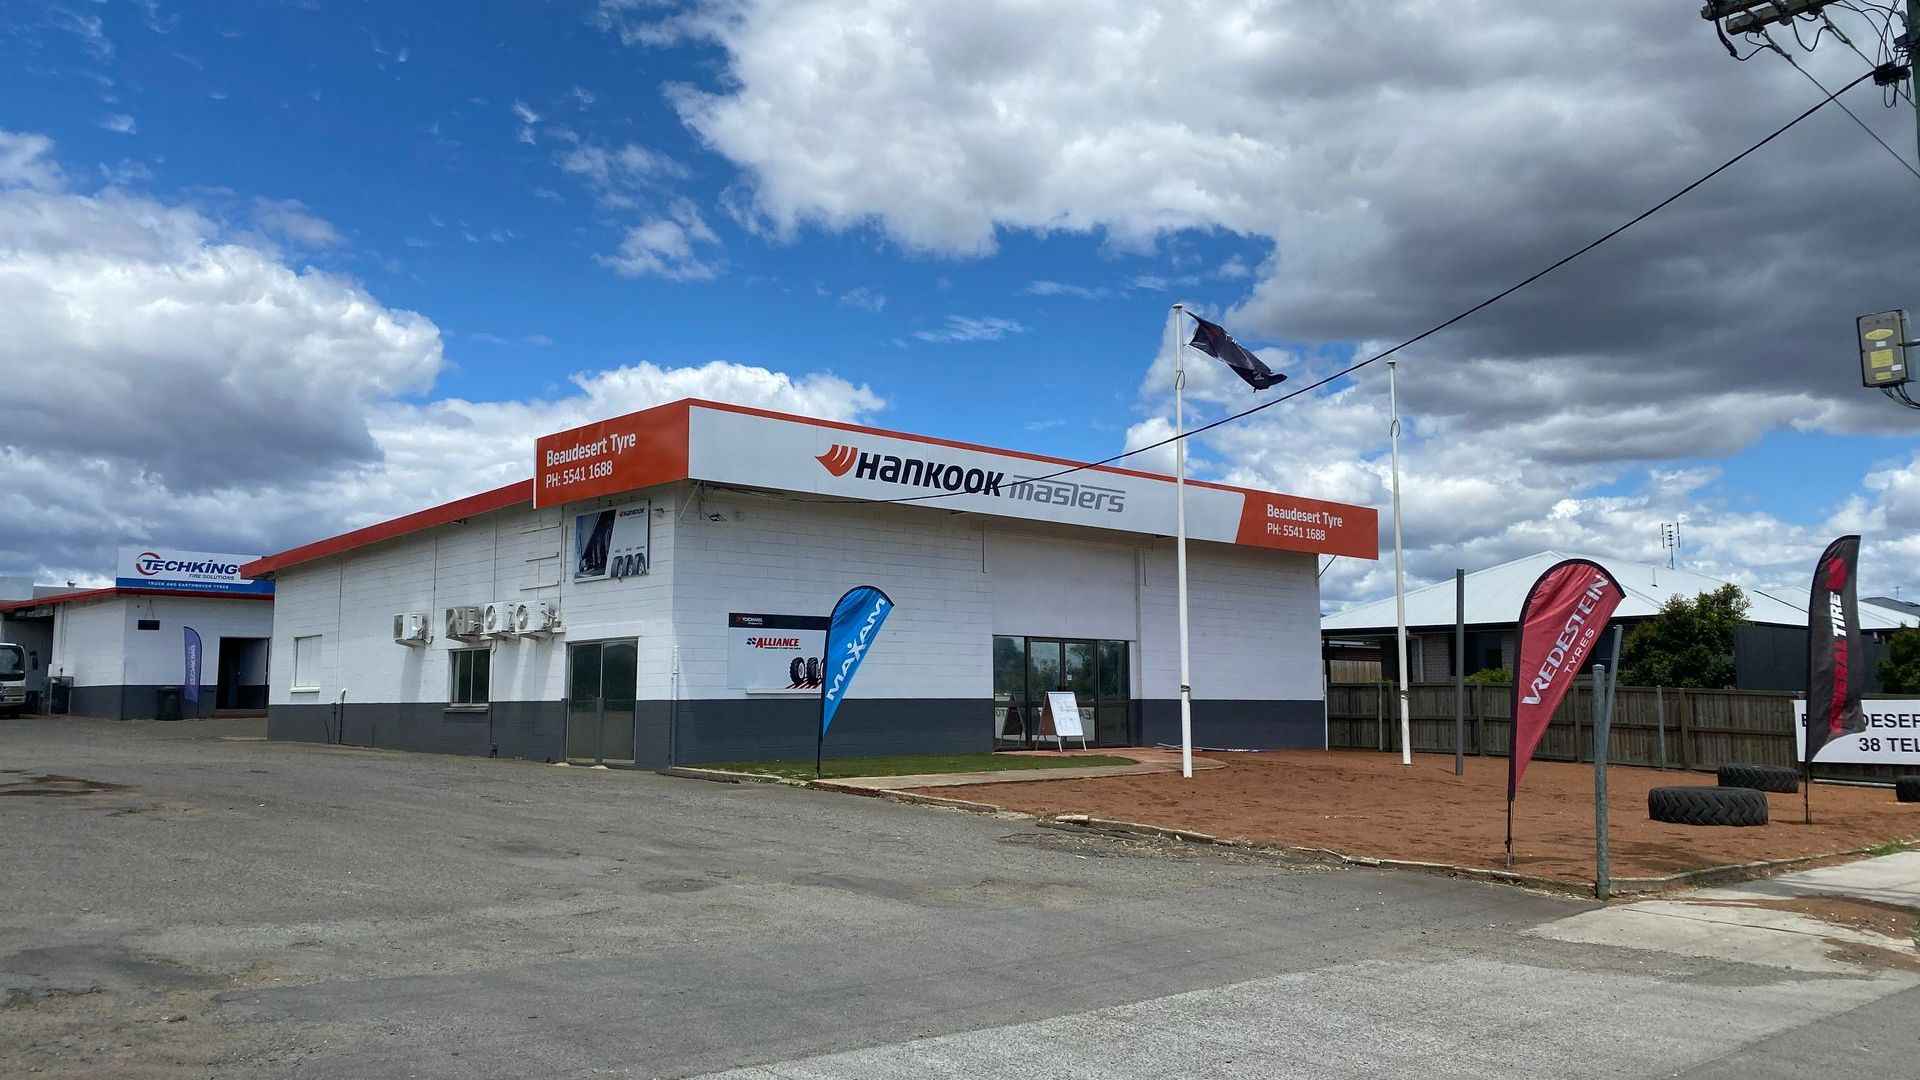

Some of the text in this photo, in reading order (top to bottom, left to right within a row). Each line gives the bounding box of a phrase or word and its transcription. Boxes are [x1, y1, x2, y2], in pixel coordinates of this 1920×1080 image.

[546, 433, 636, 467] Beaudesert Tyre
[545, 460, 613, 489] PH: 5541 1688
[1266, 503, 1343, 529] Beaudesert Tyre
[1267, 522, 1326, 541] PH: 5541 1688
[142, 559, 238, 575] TECHKING
[1830, 591, 1847, 637] TIRE
[755, 637, 800, 649] ALLIANCE
[826, 597, 886, 701] MAXAM
[1521, 574, 1609, 705] VREDESTEIN
[1563, 628, 1595, 674] TYRES
[1859, 737, 1881, 752] 38
